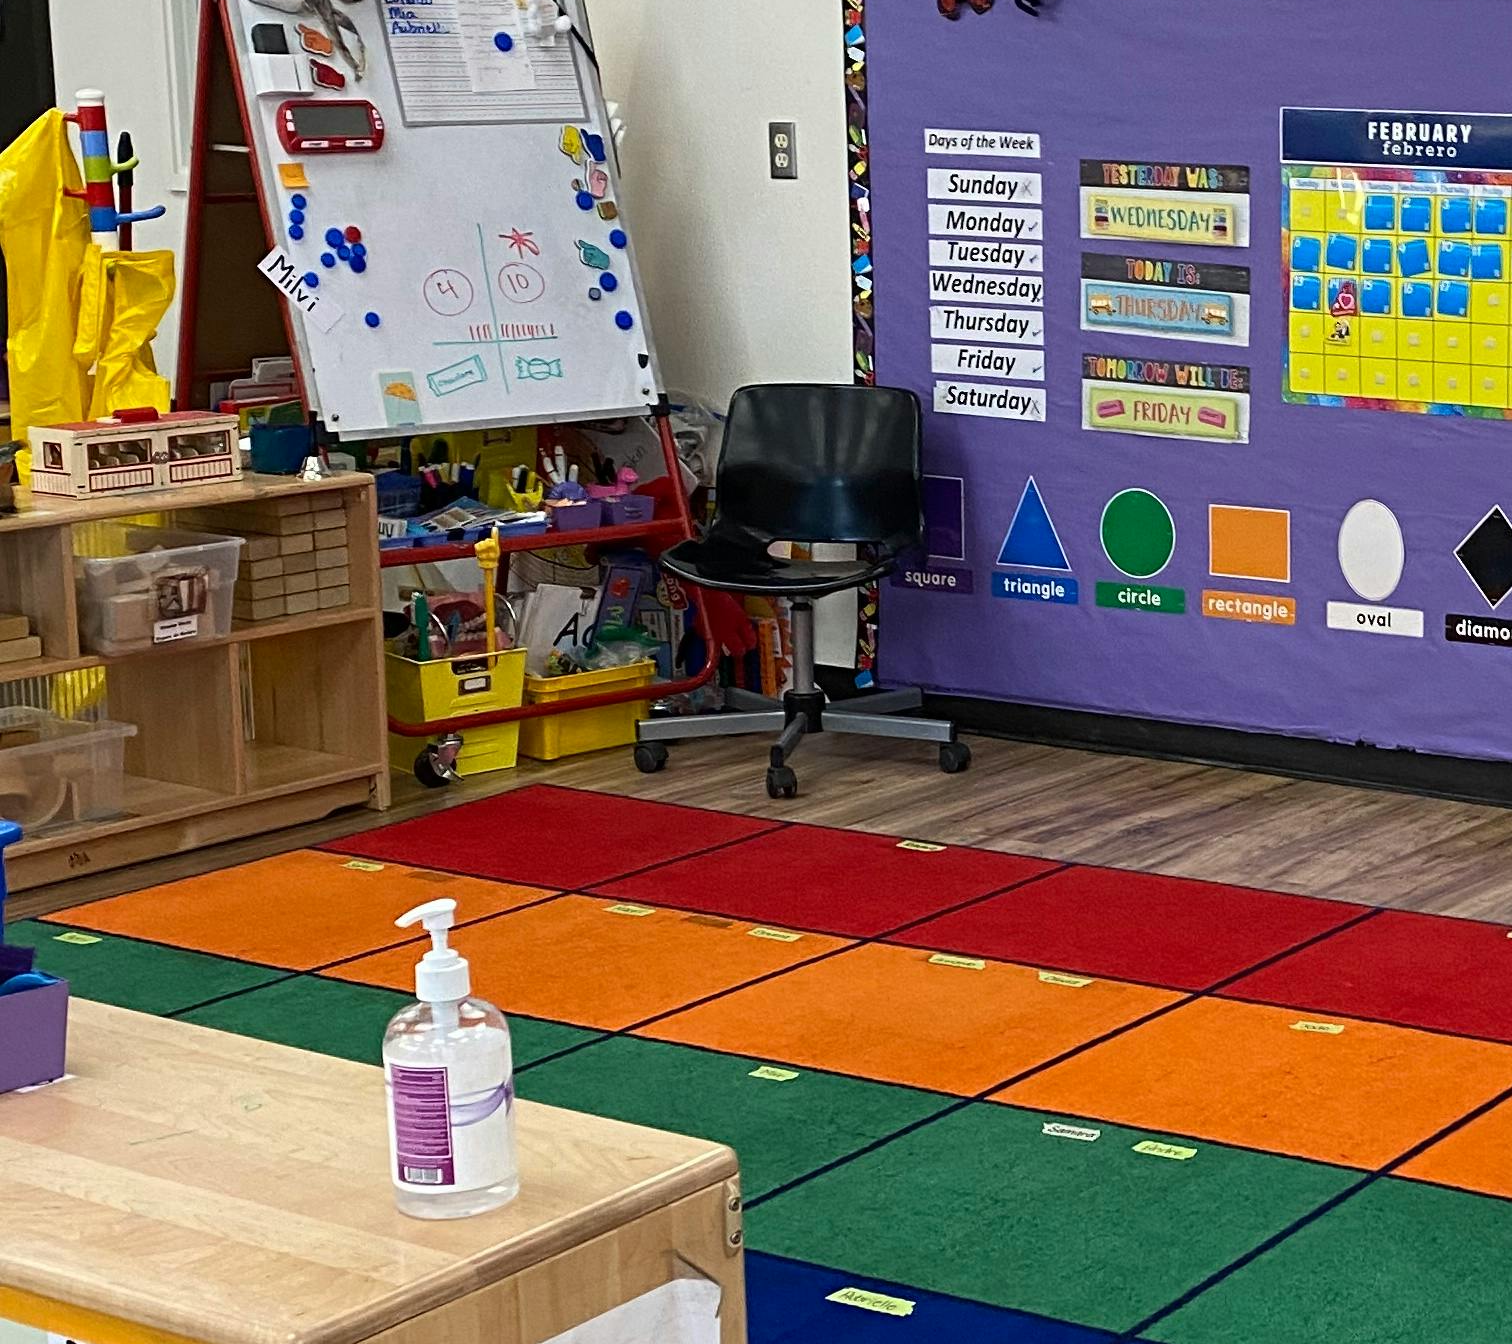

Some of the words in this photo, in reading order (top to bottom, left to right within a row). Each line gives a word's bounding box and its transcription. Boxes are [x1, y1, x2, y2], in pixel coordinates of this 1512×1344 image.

[928, 133, 957, 150] Days
[960, 134, 975, 149] of
[976, 135, 996, 150] the
[998, 135, 1035, 151] Week
[1367, 121, 1473, 144] FEBRUARY
[1382, 141, 1458, 158] febrero
[947, 174, 1019, 200] Sunday
[1102, 163, 1181, 188] YESTERDAY
[946, 210, 1025, 238] Monday
[1110, 205, 1212, 232] WEDNESDAY
[947, 242, 1025, 268] Tuesday
[507, 272, 530, 294] 10
[1126, 258, 1173, 284] TODAY
[436, 279, 460, 299] 4
[931, 273, 1042, 302] Wednesday
[1115, 294, 1203, 323] THURSDAY
[943, 309, 1029, 338] Thursday
[957, 349, 1017, 375] Friday
[1088, 357, 1168, 383] TOMORROW
[1174, 363, 1217, 387] WILL
[945, 386, 1033, 414] Saturday
[1132, 400, 1192, 425] FRIDAY
[904, 571, 957, 588] square
[1003, 577, 1066, 599] triangle
[1117, 588, 1162, 607] circle
[1207, 595, 1289, 620] rectangle
[1356, 611, 1393, 629] oval
